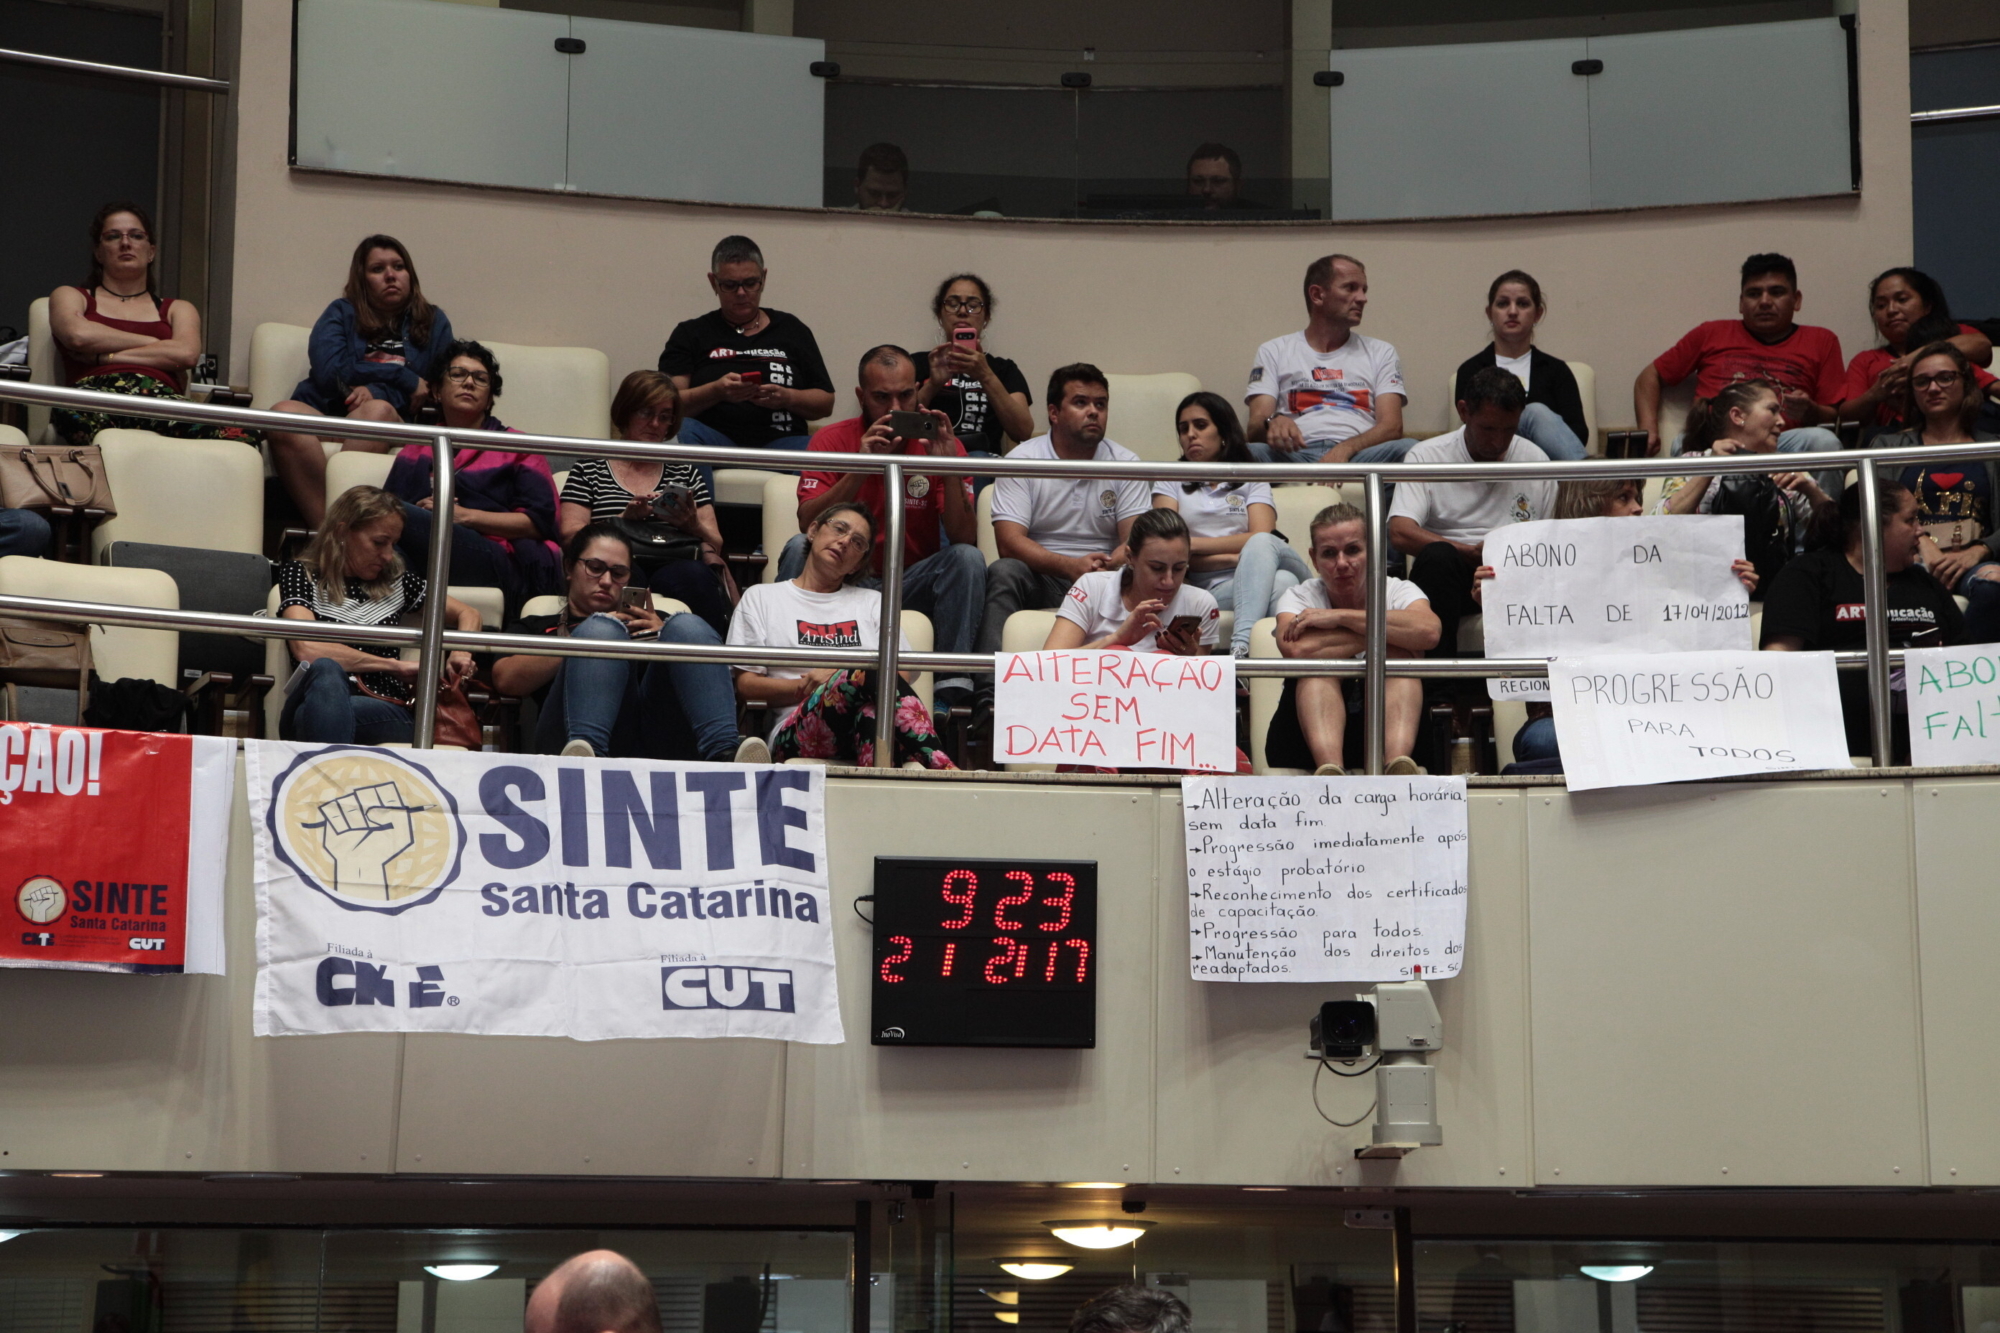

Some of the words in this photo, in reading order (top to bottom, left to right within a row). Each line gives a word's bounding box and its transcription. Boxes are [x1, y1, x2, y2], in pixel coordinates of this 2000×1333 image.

[1503, 543, 1577, 567] ABONO
[1633, 544, 1662, 564] DA
[1507, 603, 1574, 626] FALTA
[1606, 603, 1633, 623] DE
[1663, 603, 1749, 622] 17/04/2012
[1571, 666, 1774, 705] PROGRESSÃO
[1061, 693, 1142, 726] SEM
[1005, 724, 1107, 757] DATA
[1628, 719, 1695, 738] PARA
[1688, 745, 1796, 763] TODOS
[1202, 787, 1301, 810] Alteração
[1318, 784, 1342, 805] da
[1354, 793, 1397, 816] carga
[478, 765, 816, 873] SINTE
[1188, 820, 1222, 831] sem
[1239, 813, 1277, 830] data
[1202, 835, 1295, 864] Progressão
[1313, 826, 1425, 849] imediatamente
[1437, 830, 1467, 850] após
[1189, 867, 1197, 877] o
[1207, 861, 1262, 884] estágio
[1281, 858, 1366, 885] probatório
[72, 880, 168, 916] SINTE
[480, 881, 610, 920] Santa
[627, 879, 820, 924] Catarina
[941, 869, 978, 929] 9
[1202, 881, 1332, 901] Reconhecimento
[1347, 883, 1373, 899] dos
[1387, 880, 1467, 898] certificados
[1190, 902, 1206, 918] de
[70, 915, 107, 930] Santa
[111, 917, 166, 932] Catarina
[1203, 921, 1298, 948] Progressão
[1323, 930, 1357, 949] para
[129, 938, 165, 950] CUT
[327, 943, 364, 957] Filiada
[366, 949, 373, 959] à
[1205, 942, 1296, 959] Manutenção
[1324, 943, 1351, 957] dos
[1371, 943, 1430, 958] direitos
[1444, 940, 1463, 955] dos
[660, 954, 697, 963] Filiada
[700, 953, 706, 961] à
[664, 967, 791, 1010] CUT
